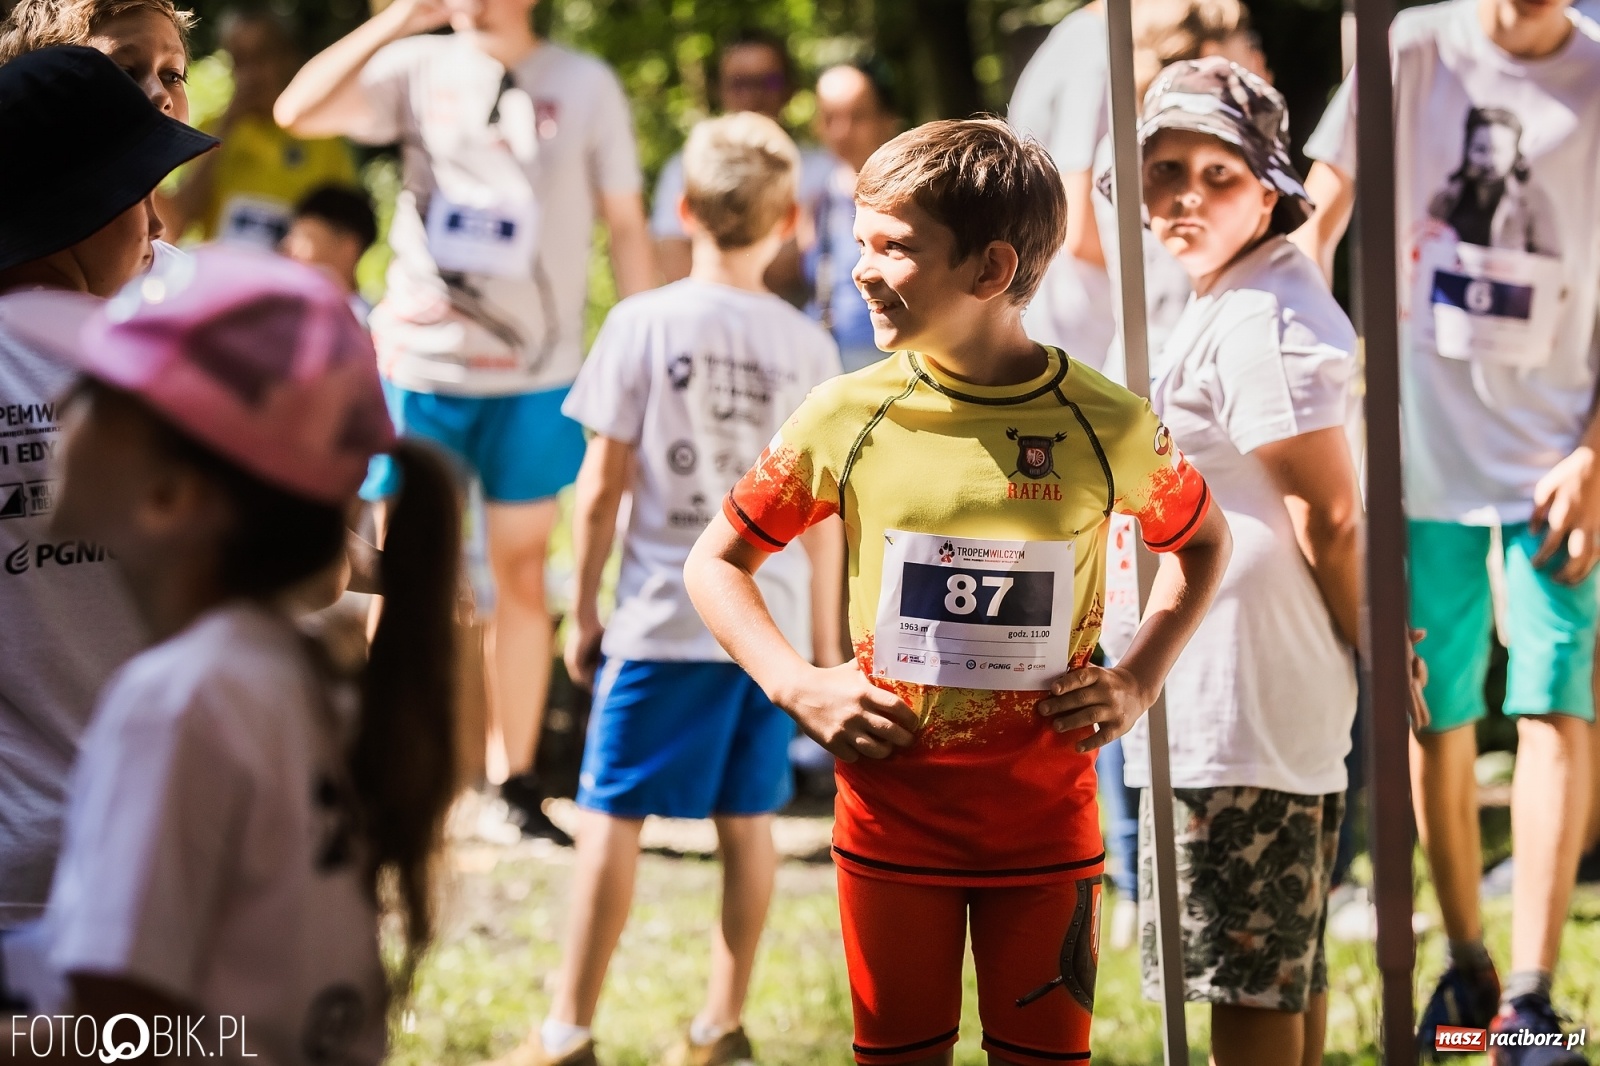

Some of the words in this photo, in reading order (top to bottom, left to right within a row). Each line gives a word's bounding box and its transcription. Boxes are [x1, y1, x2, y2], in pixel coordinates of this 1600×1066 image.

[1007, 482, 1063, 501] RAFAŁ
[957, 546, 1025, 560] TROPEMWILCZYM
[944, 573, 1014, 617] 87
[900, 622, 919, 632] 1963
[1008, 630, 1029, 640] godz.
[1030, 630, 1050, 639] 11.00
